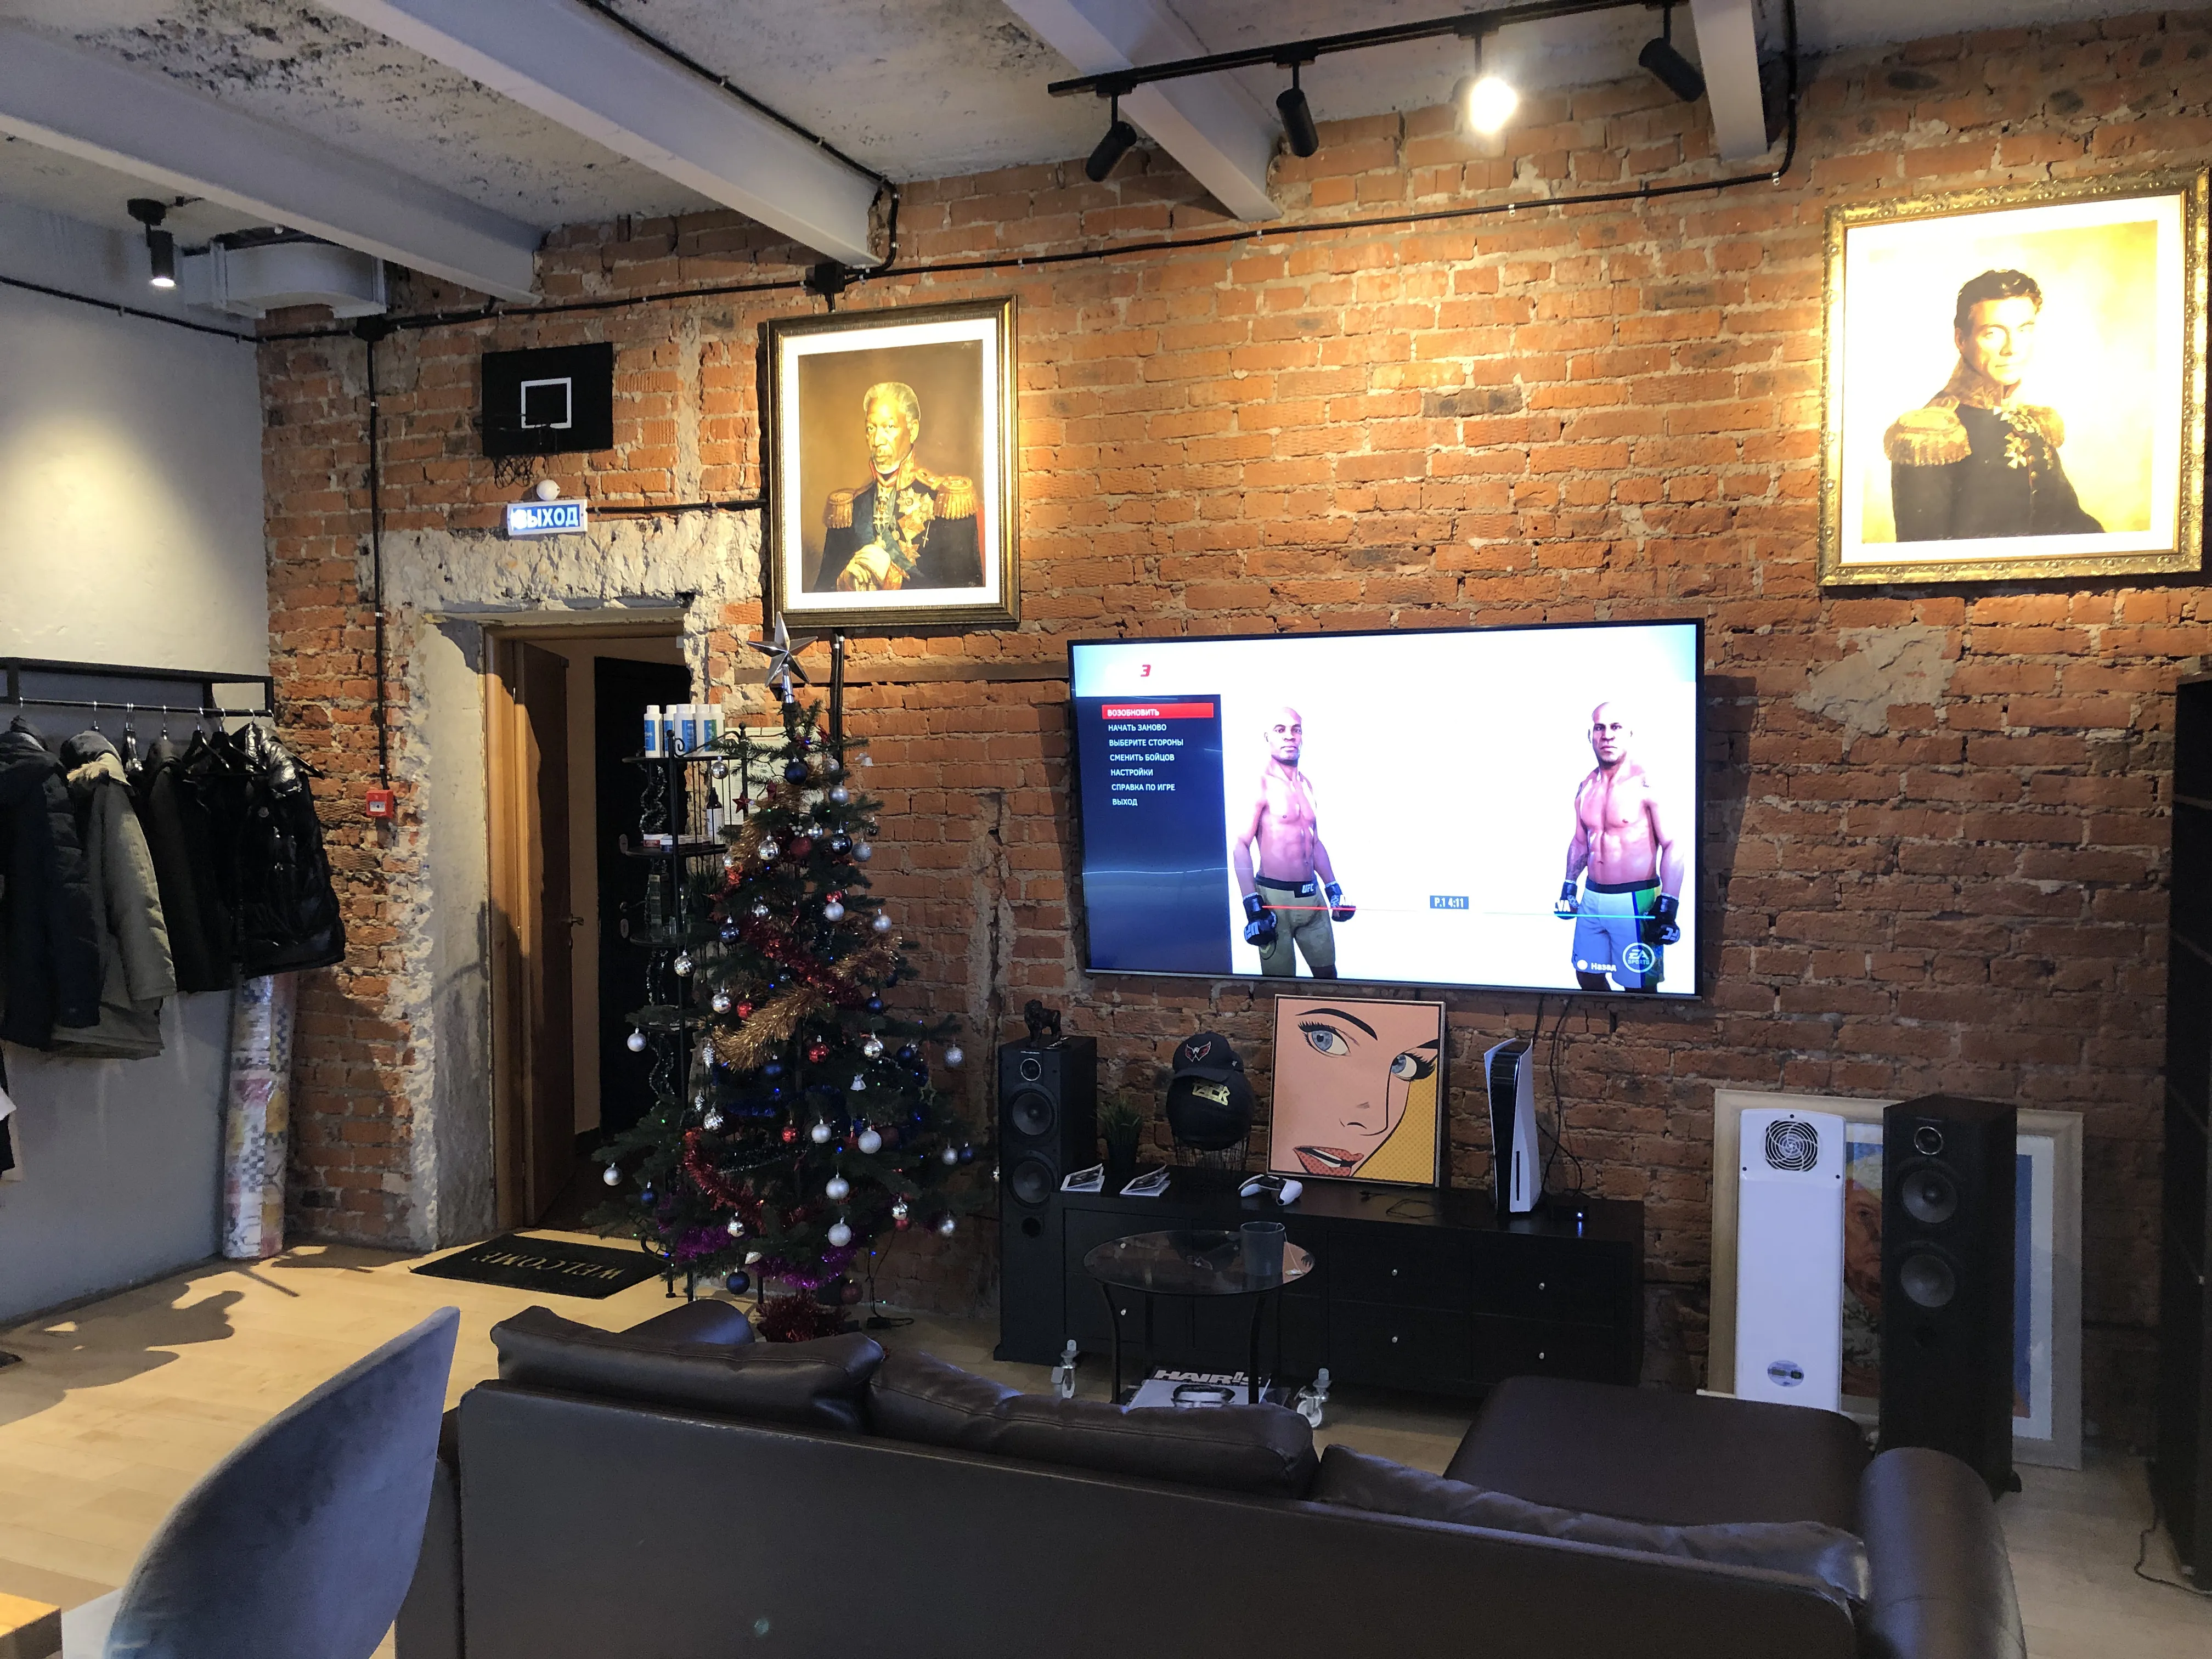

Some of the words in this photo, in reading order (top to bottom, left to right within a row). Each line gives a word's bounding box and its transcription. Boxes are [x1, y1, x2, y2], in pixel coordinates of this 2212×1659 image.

[1141, 664, 1151, 676] 3
[1107, 708, 1160, 717] ВОЗОБНОВИТЬ
[1145, 752, 1175, 762] БОЙЦОВ
[1110, 768, 1153, 776] НАСТРОЙКИ
[1301, 883, 1314, 894] UFC
[1448, 897, 1464, 908] 4:11
[1629, 949, 1649, 960] EA
[1590, 962, 1617, 972] Назад
